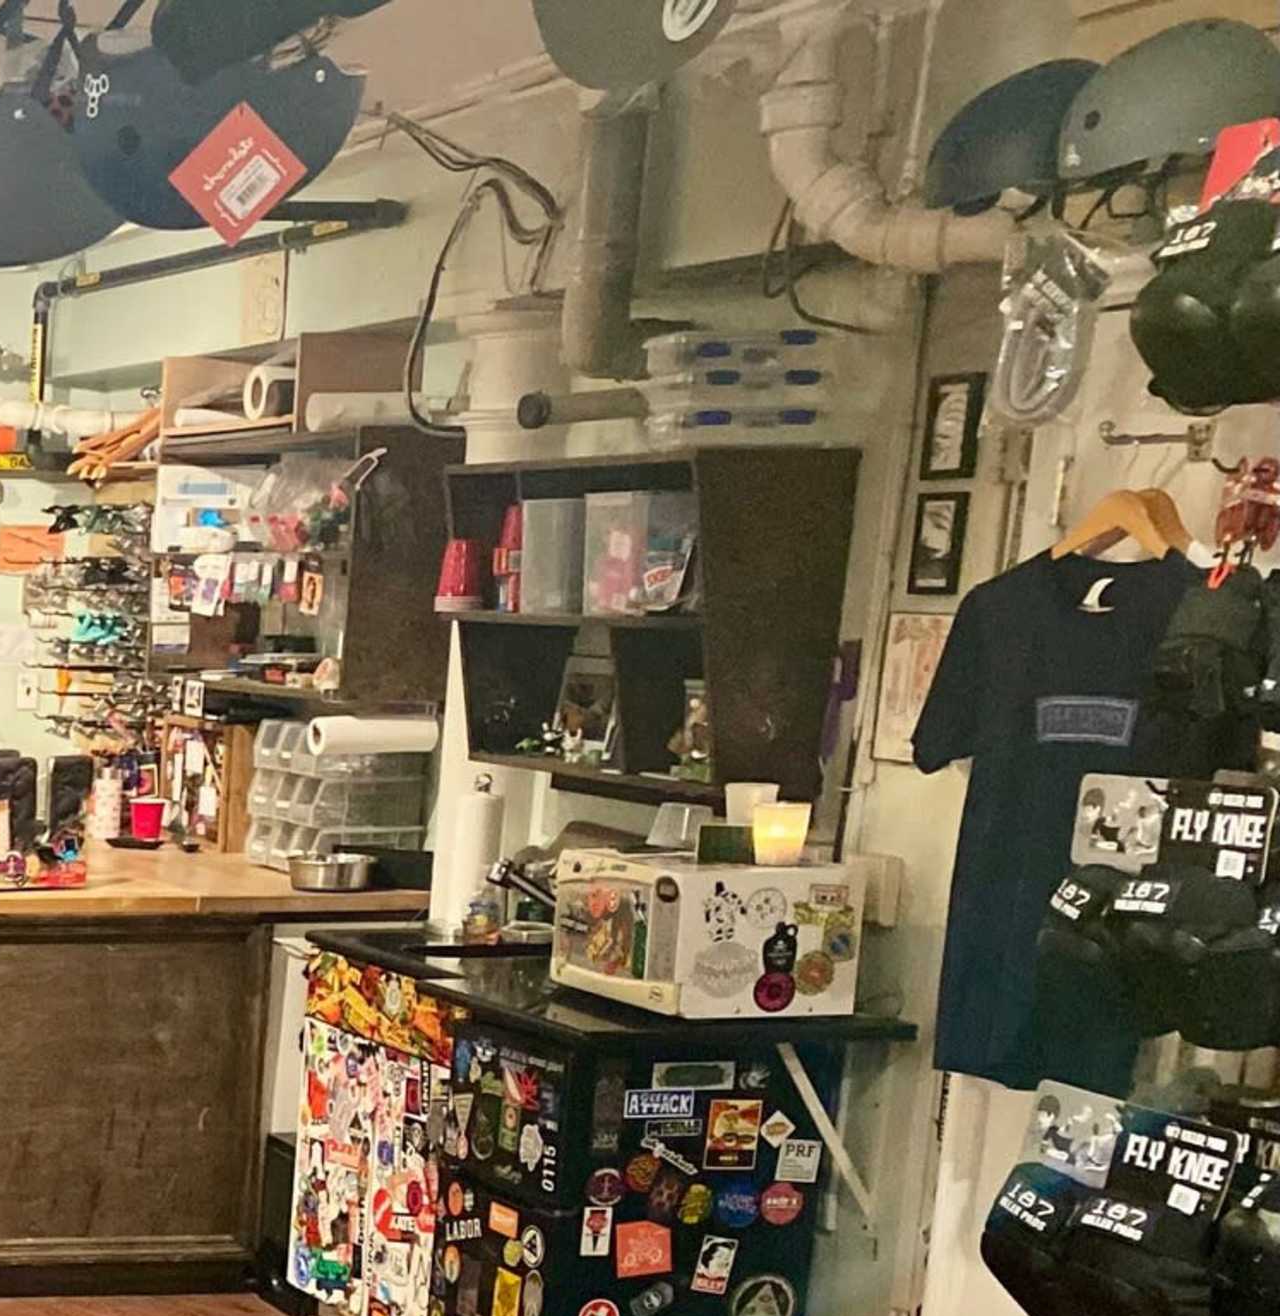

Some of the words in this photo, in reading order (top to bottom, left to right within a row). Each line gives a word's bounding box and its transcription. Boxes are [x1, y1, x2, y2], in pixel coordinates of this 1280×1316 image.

[1170, 809, 1210, 843] FLY
[1211, 813, 1266, 849] KNEE
[1057, 878, 1091, 906] 187
[1121, 882, 1171, 900] 187
[629, 1095, 693, 1114] ATTACK
[1123, 1133, 1166, 1172] FLY
[1167, 1148, 1230, 1191] KNEE
[1007, 1183, 1055, 1216] 187
[1091, 1199, 1148, 1226] 187
[445, 1218, 482, 1241] LABOR
